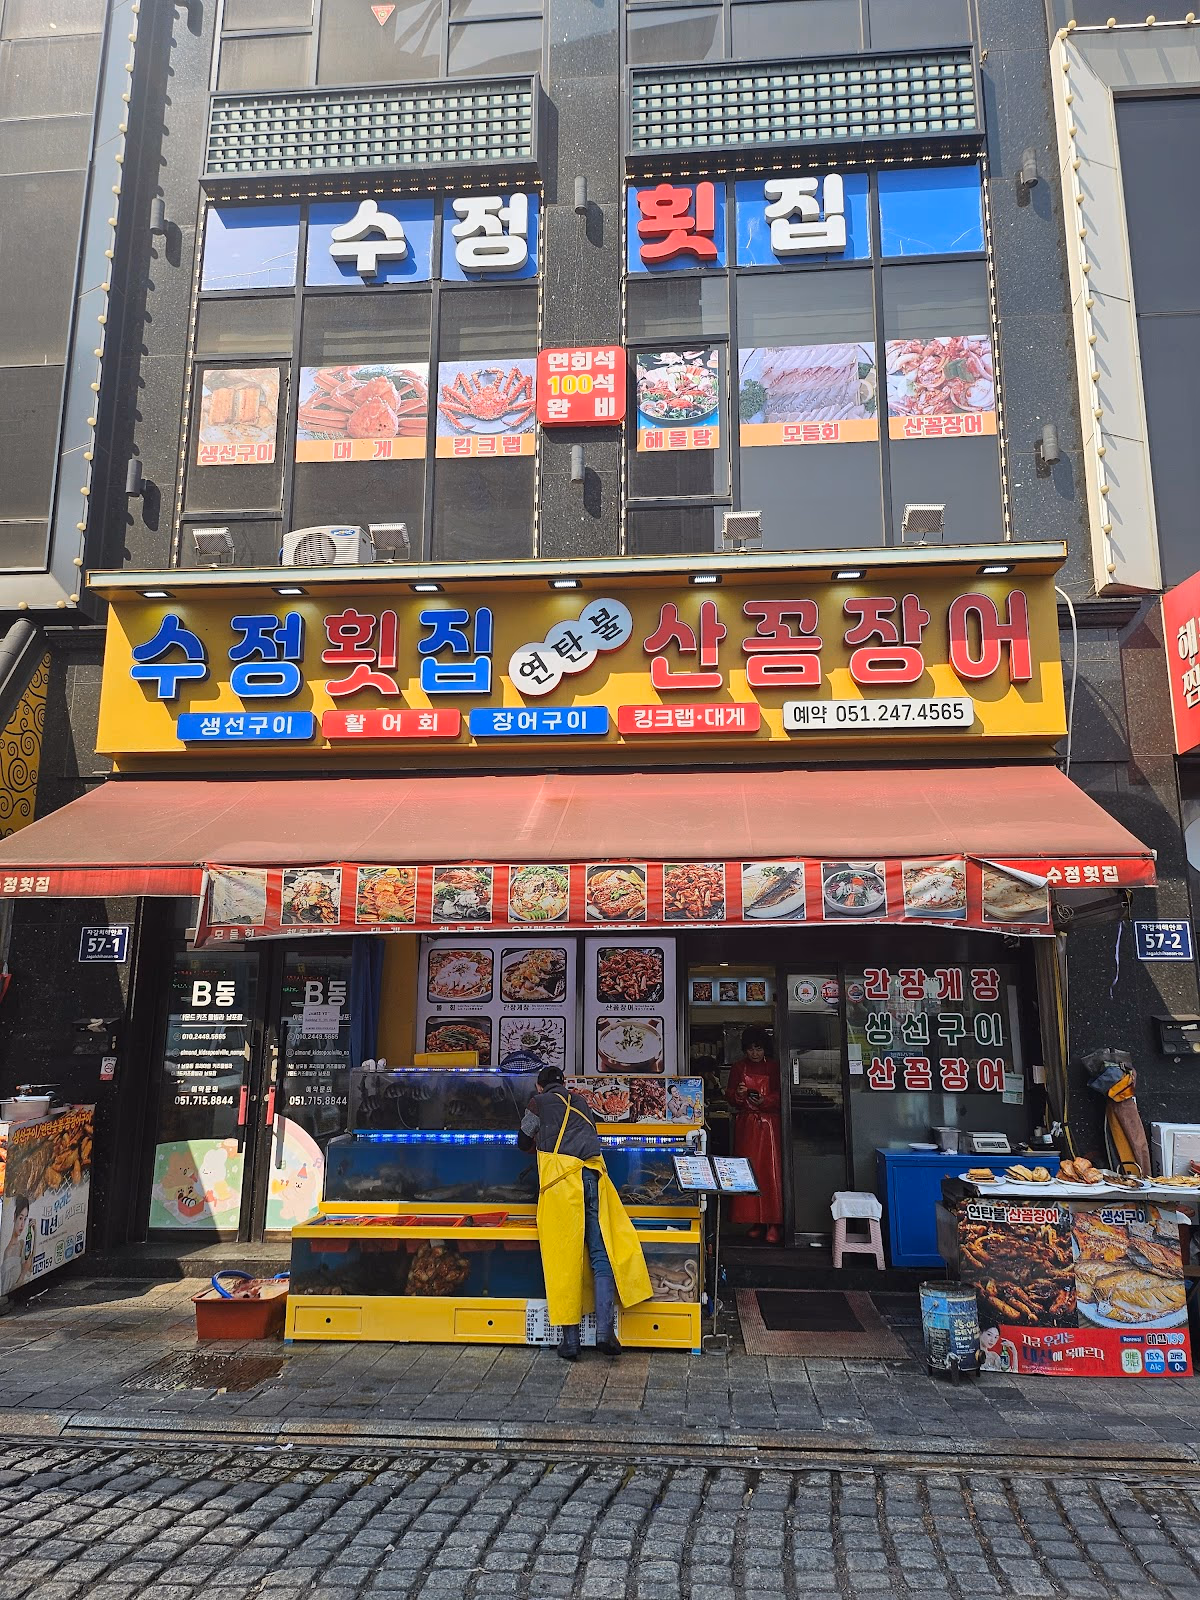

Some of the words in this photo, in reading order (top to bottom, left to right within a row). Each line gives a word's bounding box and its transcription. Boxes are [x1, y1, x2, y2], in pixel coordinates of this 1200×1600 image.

[329, 193, 529, 276] 수정
[637, 174, 846, 262] 횟집
[546, 350, 616, 372] 연회석
[546, 374, 615, 395] 100석
[783, 422, 840, 443] 모듬회
[903, 413, 983, 437] 산꼼장어
[453, 435, 522, 456] 킹크랩
[644, 429, 713, 450] 해물탕
[200, 443, 274, 464] 생선구이
[519, 607, 624, 685] 연탄불
[643, 589, 1032, 689] 산꼼장어
[130, 607, 493, 699] 수정횟집
[492, 710, 587, 731] 장어구이
[793, 705, 828, 724] 예약
[836, 702, 965, 722] 051.247.4565
[199, 715, 293, 736] 생선구이
[0, 876, 50, 893] 정횟집
[1047, 864, 1119, 884] 수정횟집
[87, 938, 120, 952] 57-1
[1145, 933, 1182, 948] 57-2
[192, 981, 236, 1007] B동
[305, 981, 347, 1006] B동
[864, 968, 1000, 1000] 간장게장
[865, 1012, 1003, 1046] 생선구이
[867, 1057, 1006, 1092] 산꼼장어
[174, 1095, 234, 1106] 051.715.8844
[289, 1096, 348, 1105] 051.715.8844
[967, 1204, 1007, 1222] 연탄불
[1008, 1207, 1060, 1223] 산꼼장어
